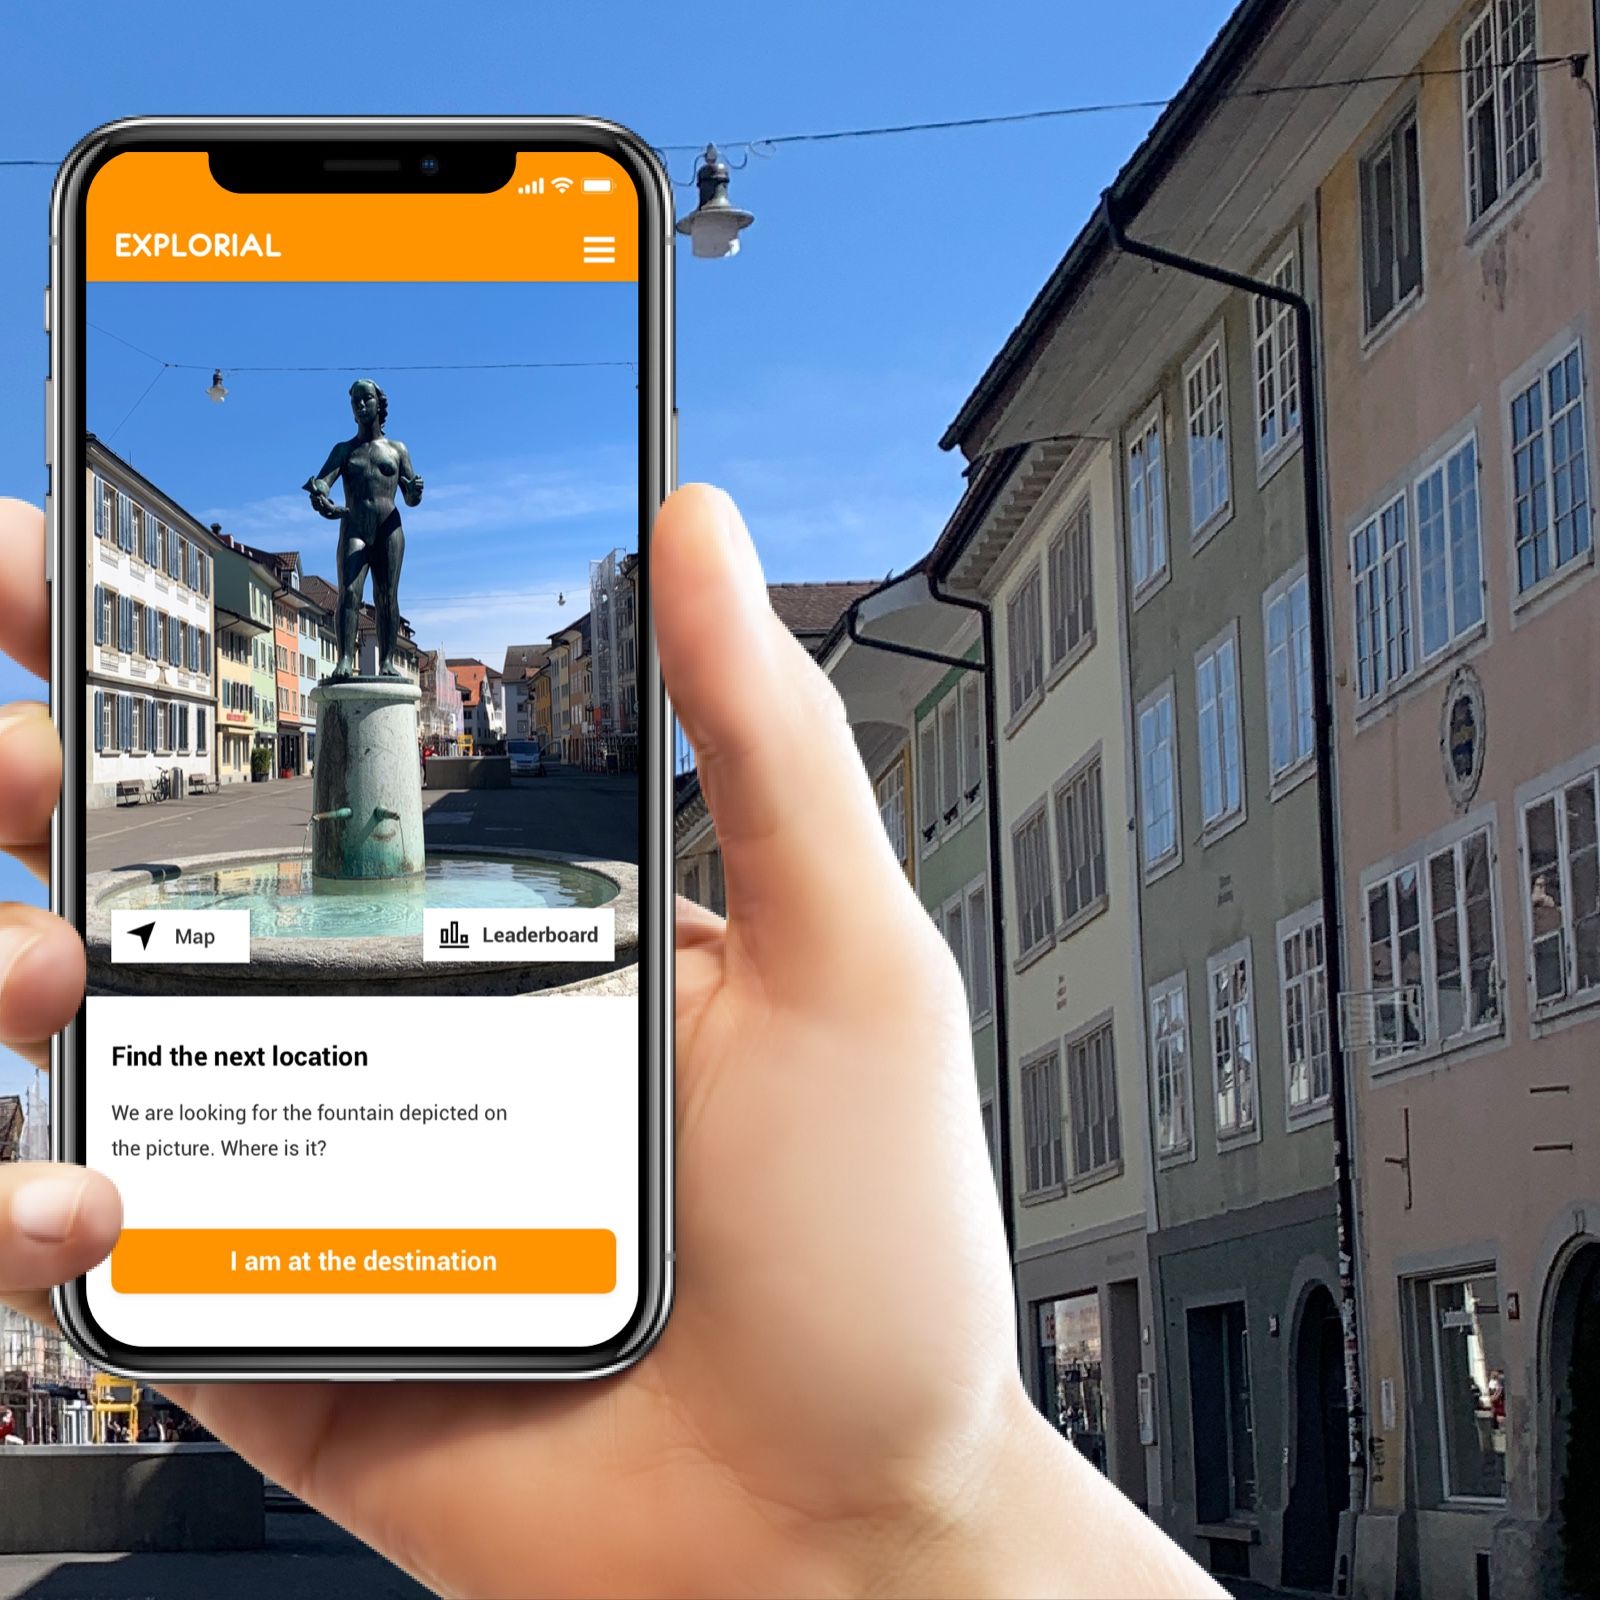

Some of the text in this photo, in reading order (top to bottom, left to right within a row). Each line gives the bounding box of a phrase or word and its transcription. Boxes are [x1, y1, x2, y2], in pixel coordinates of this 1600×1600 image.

[115, 232, 282, 258] EXPLORIAL
[175, 928, 216, 949] Map
[483, 925, 599, 943] Leaderboard
[112, 1045, 368, 1067] Find the next location
[111, 1103, 508, 1126] We are looking for the fountain depicted on
[111, 1138, 327, 1161] the picture. Where is it?
[230, 1249, 497, 1272] I am at the destination
